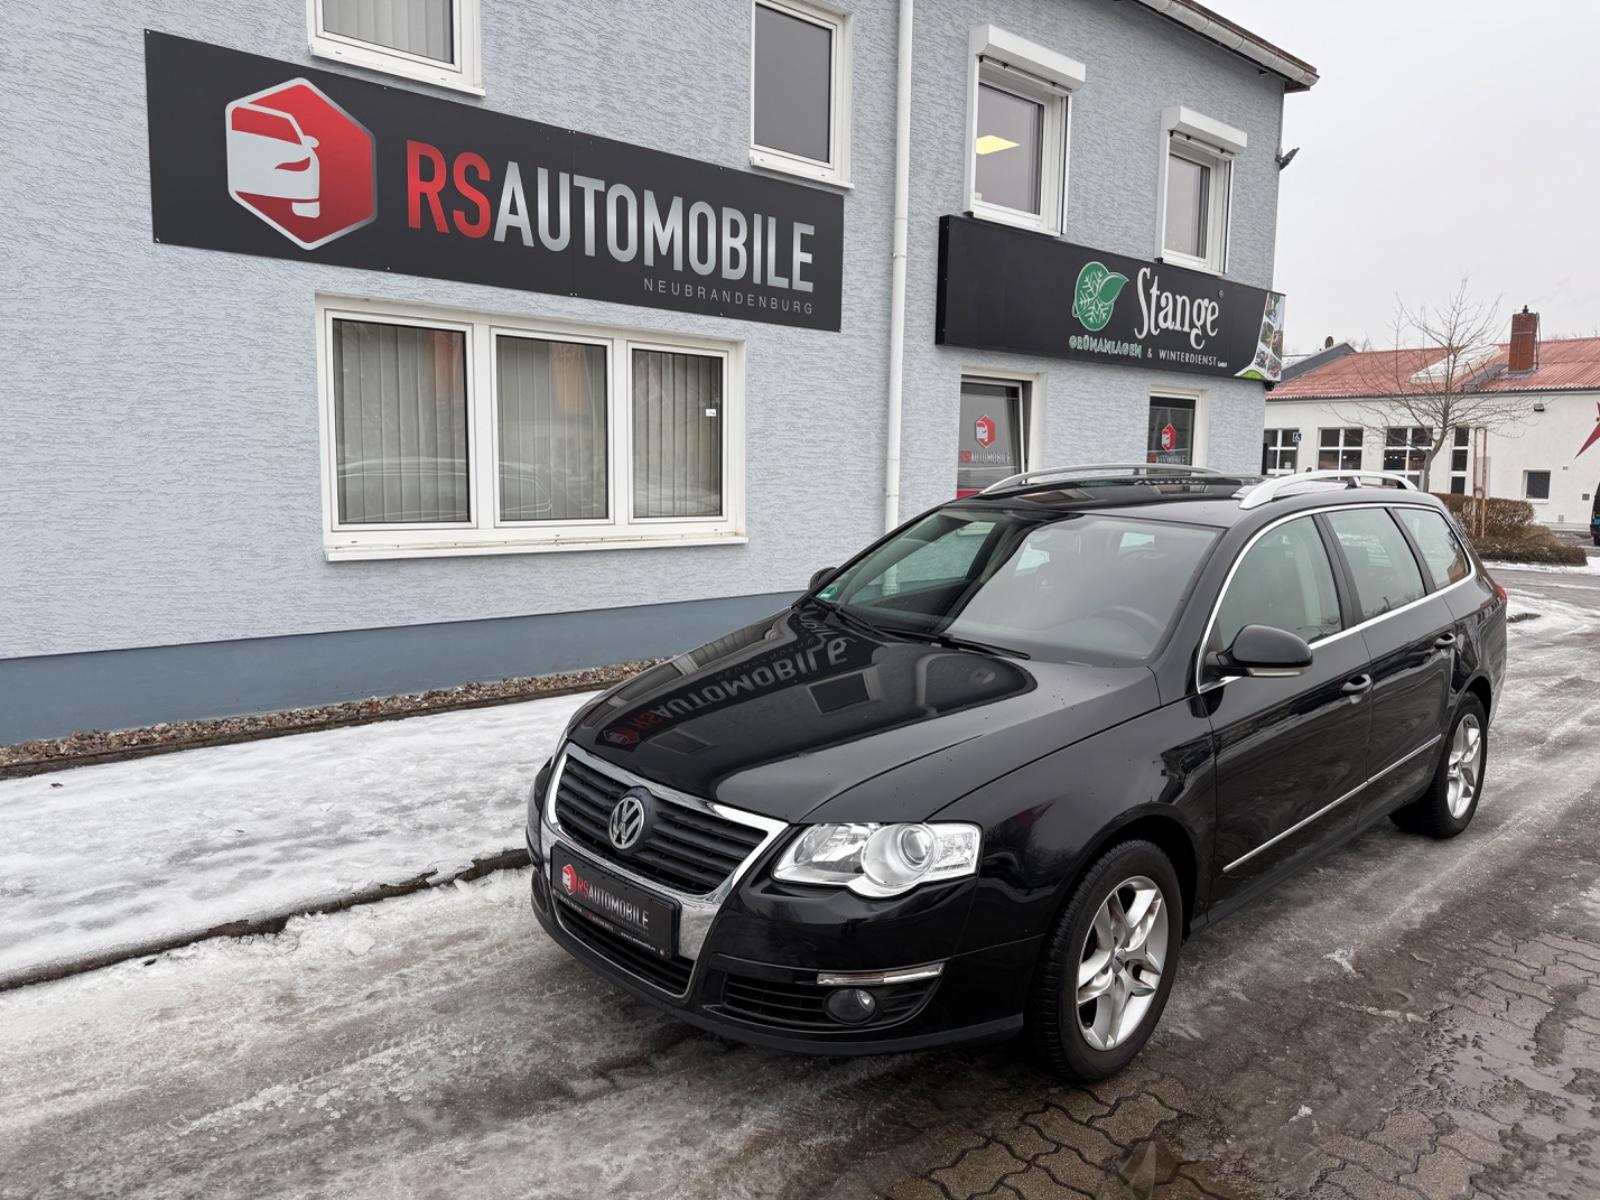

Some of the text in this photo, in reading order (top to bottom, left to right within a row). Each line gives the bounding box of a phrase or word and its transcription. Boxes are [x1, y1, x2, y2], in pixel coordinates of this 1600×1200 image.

[406, 139, 815, 293] RSAUTOMOBILE
[643, 277, 814, 316] NEUBRANDENBURG
[1134, 266, 1220, 350] Stange
[1068, 334, 1143, 359] GRÜNANLAGEN
[1146, 347, 1153, 359] &
[1158, 348, 1217, 367] WINTERDIENST
[577, 877, 649, 930] RSAUTOMOBILE
